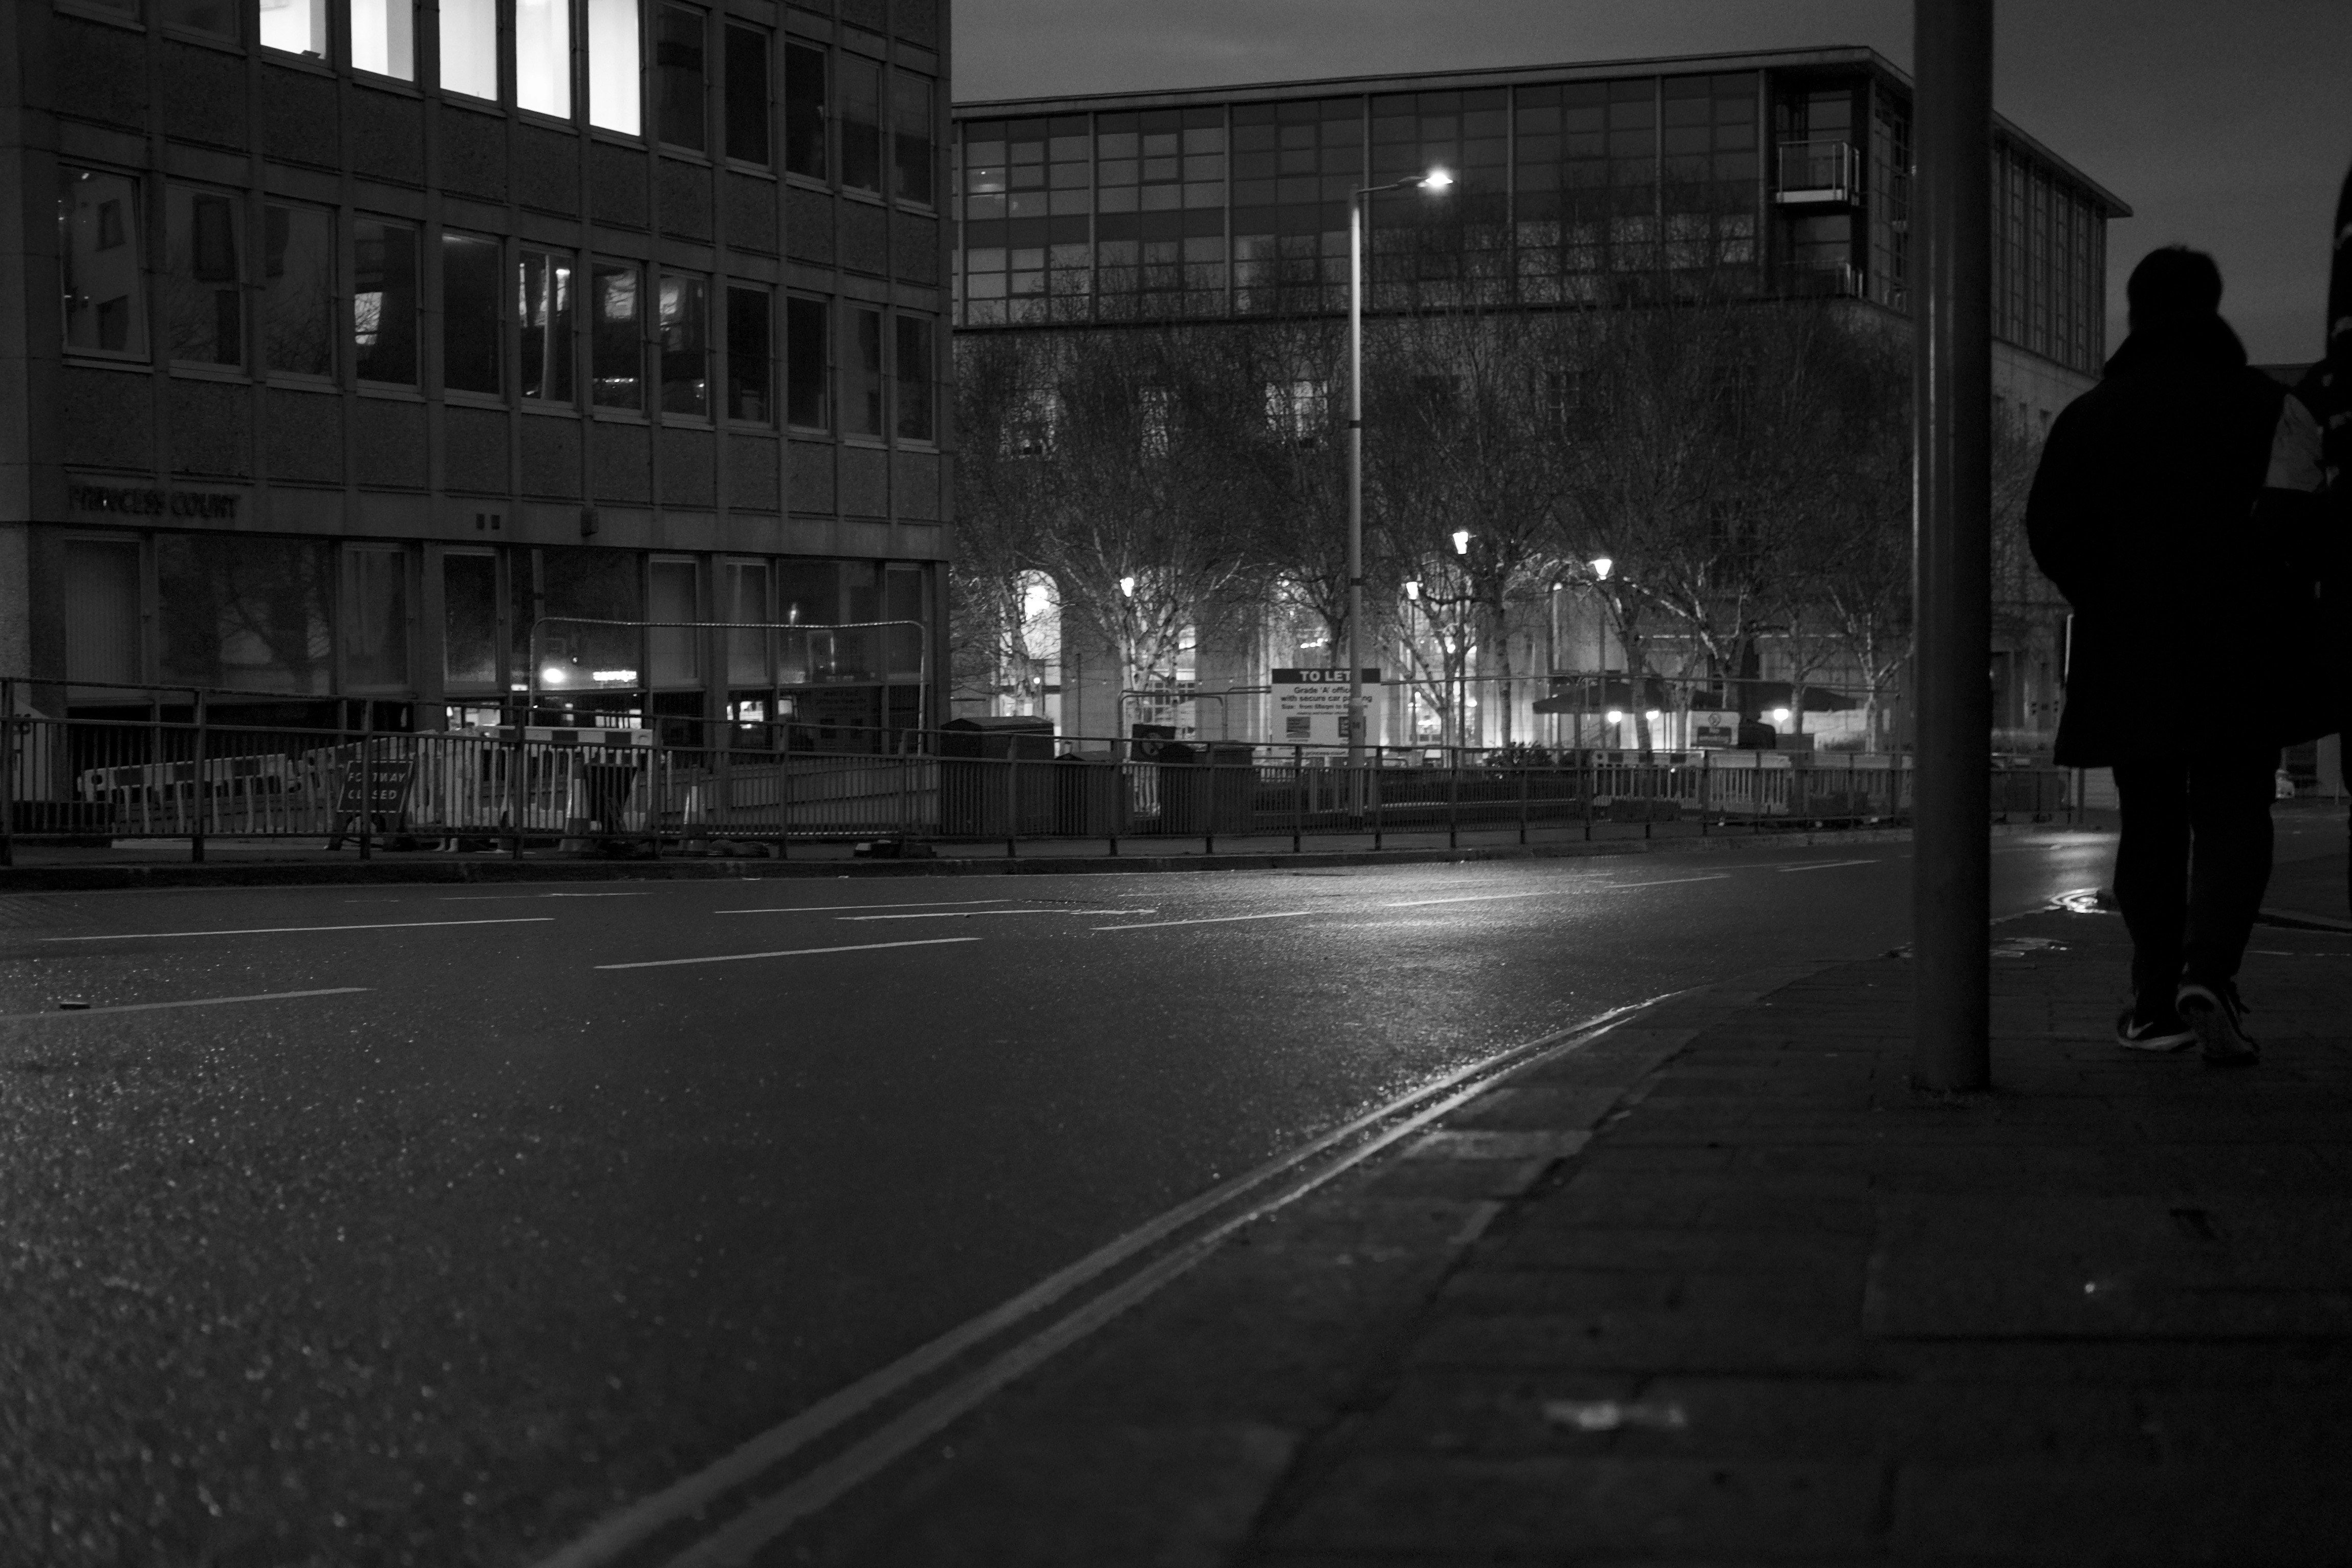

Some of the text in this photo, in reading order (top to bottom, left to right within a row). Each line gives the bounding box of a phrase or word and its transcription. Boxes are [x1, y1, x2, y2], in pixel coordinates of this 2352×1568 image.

[1299, 670, 1352, 682] TO LET
[347, 772, 406, 782] FOTWAY
[347, 790, 397, 799] CLSED
